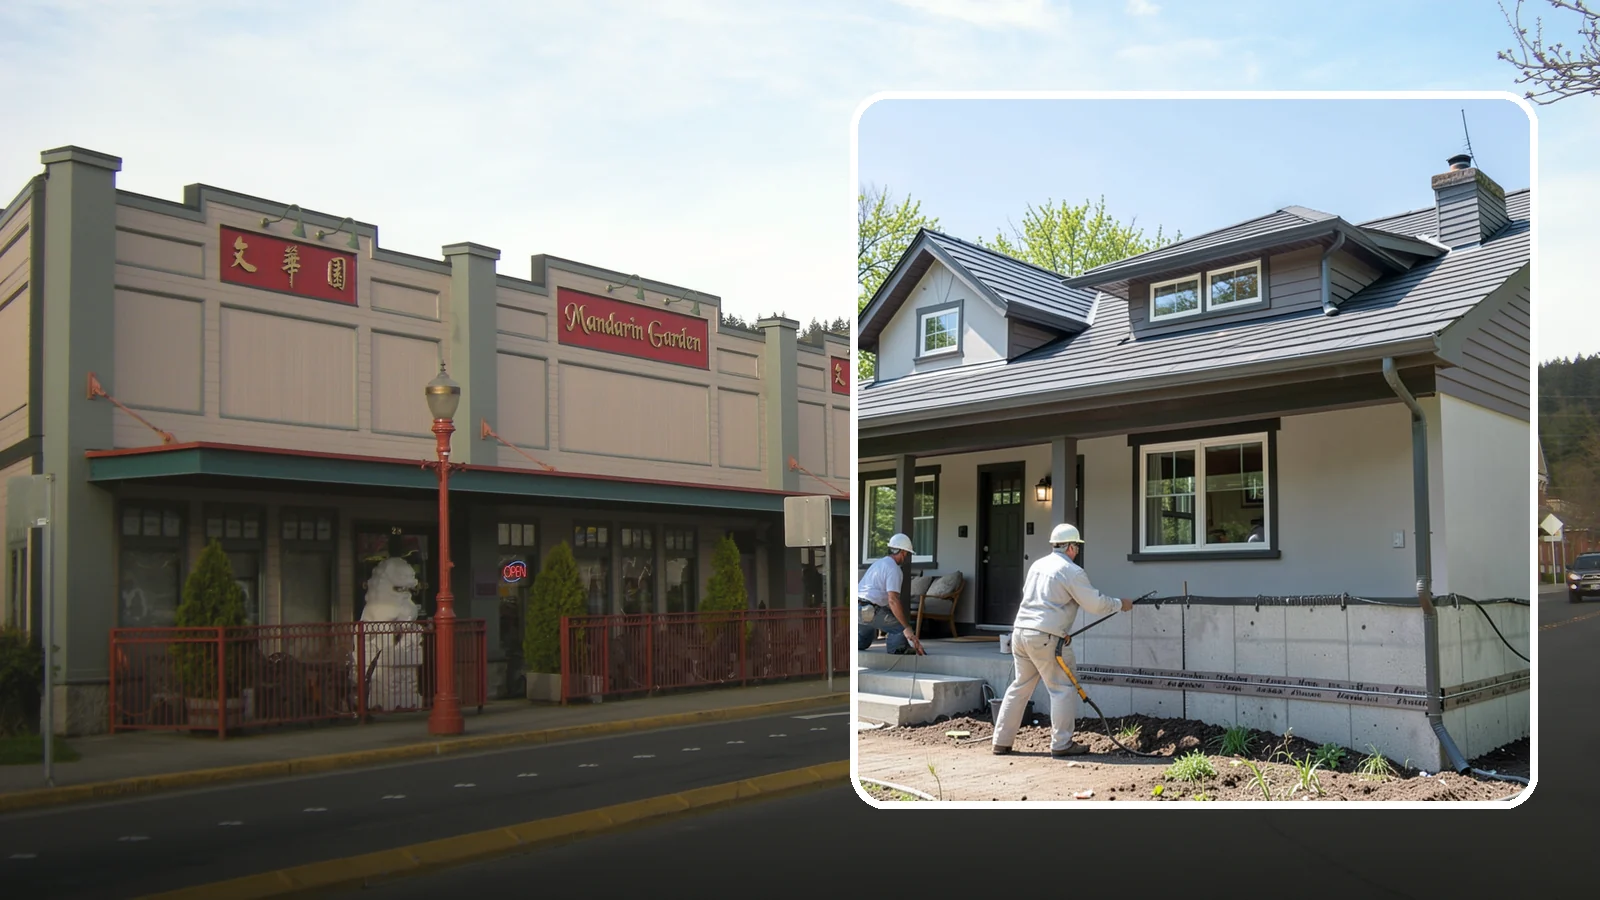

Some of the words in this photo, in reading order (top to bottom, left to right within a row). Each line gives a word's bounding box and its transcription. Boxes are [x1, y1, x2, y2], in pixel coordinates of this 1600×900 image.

[231, 235, 346, 290] 文華園
[565, 302, 644, 341] Mandarin
[648, 320, 701, 352] Garden
[503, 565, 527, 578] OPEN
